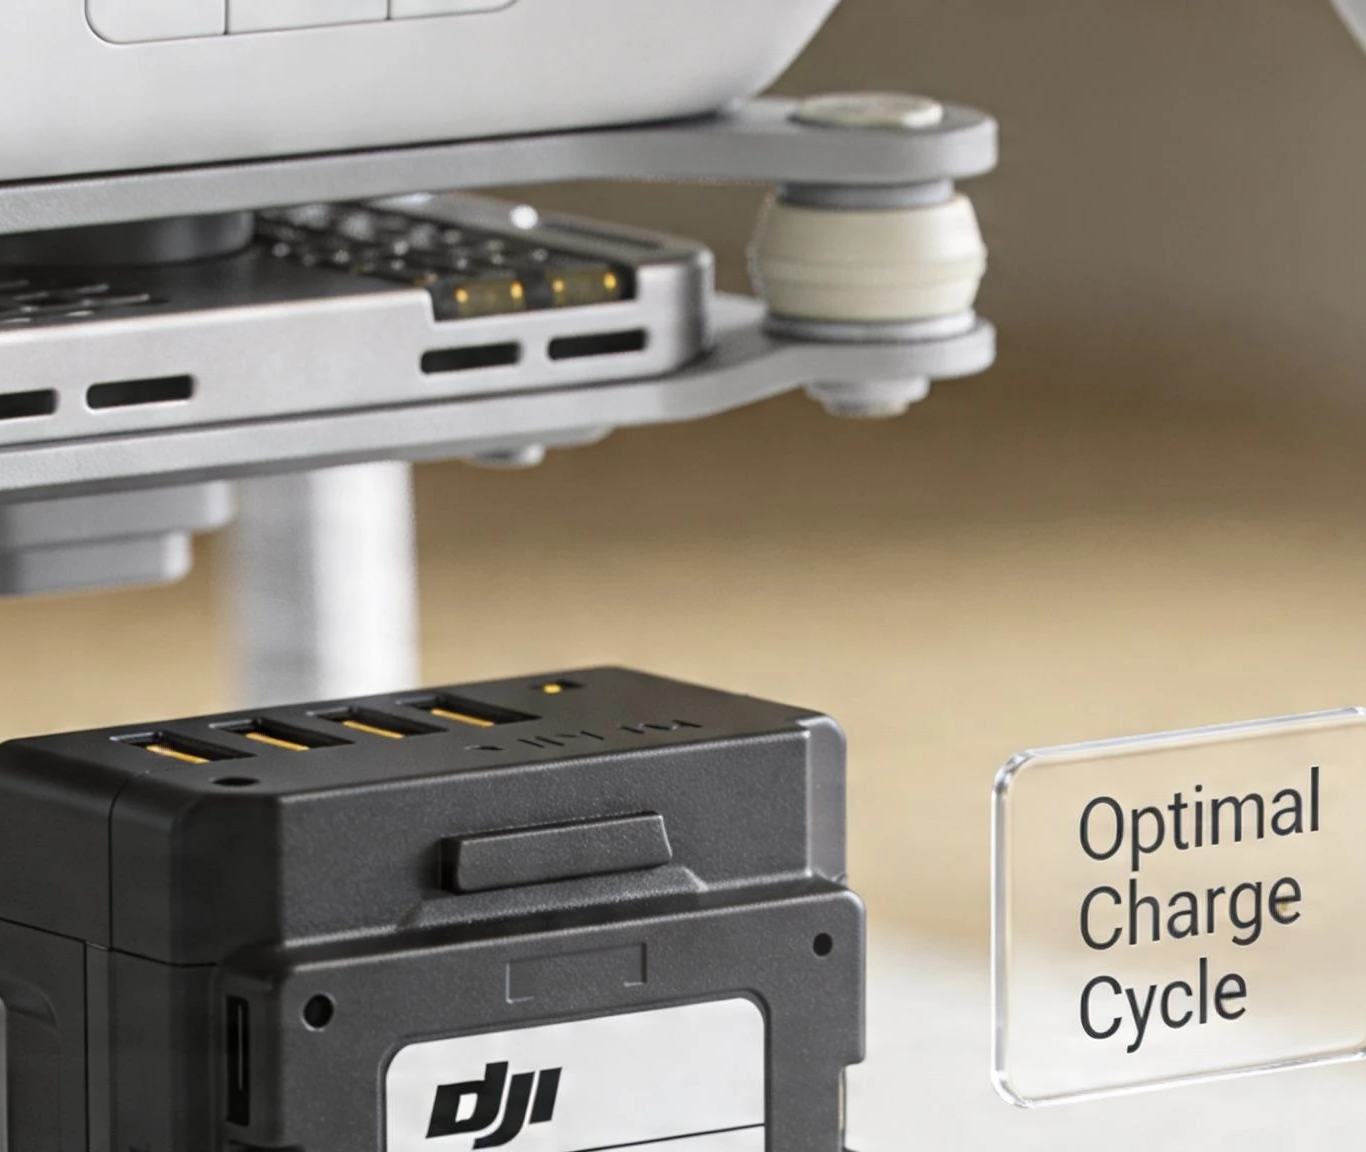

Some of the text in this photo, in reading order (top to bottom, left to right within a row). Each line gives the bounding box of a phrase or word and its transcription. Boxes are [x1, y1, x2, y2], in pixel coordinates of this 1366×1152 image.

[1079, 766, 1320, 873] Optimal
[1080, 877, 1303, 950] Charge
[1080, 957, 1248, 1054] Cycle
